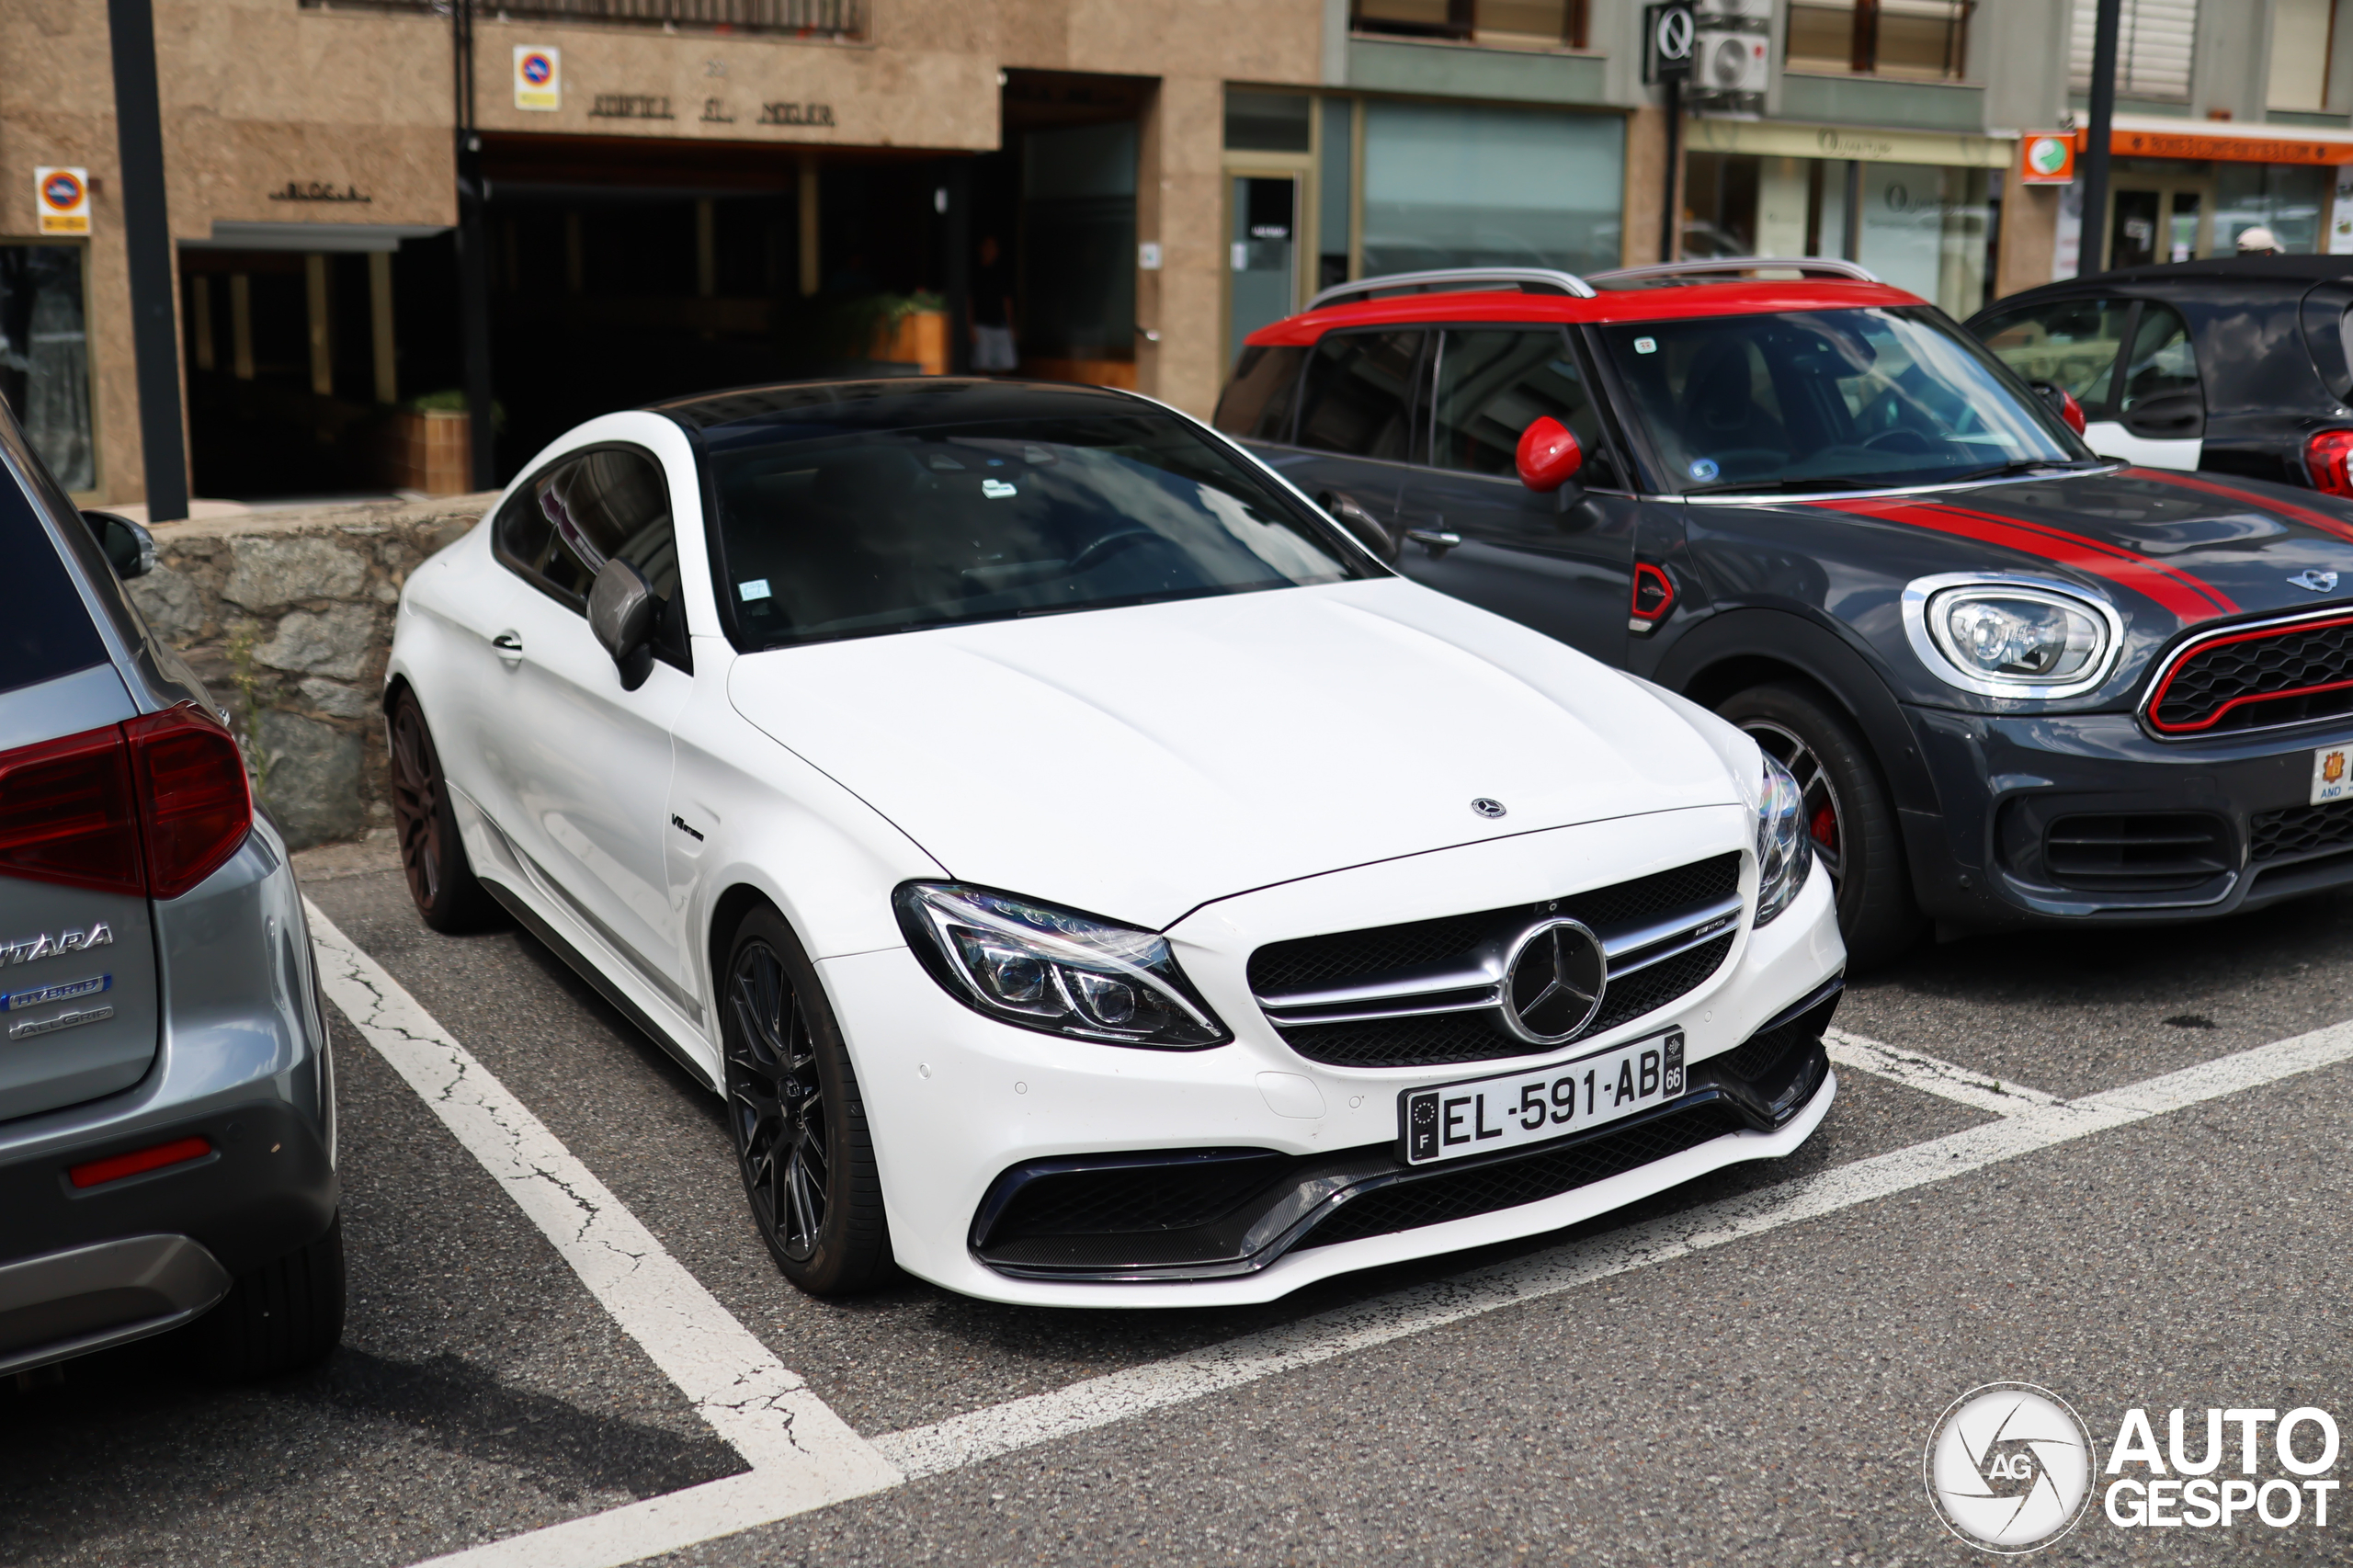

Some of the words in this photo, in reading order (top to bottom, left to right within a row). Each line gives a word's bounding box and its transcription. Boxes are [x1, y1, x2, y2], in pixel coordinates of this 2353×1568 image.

[1657, 6, 1694, 61] Q
[2321, 786, 2342, 799] AND
[17, 979, 98, 1006] HYBRID
[1665, 1066, 1681, 1091] 66
[1442, 1050, 1660, 1148] EL-591-AB
[1419, 1133, 1429, 1149] F
